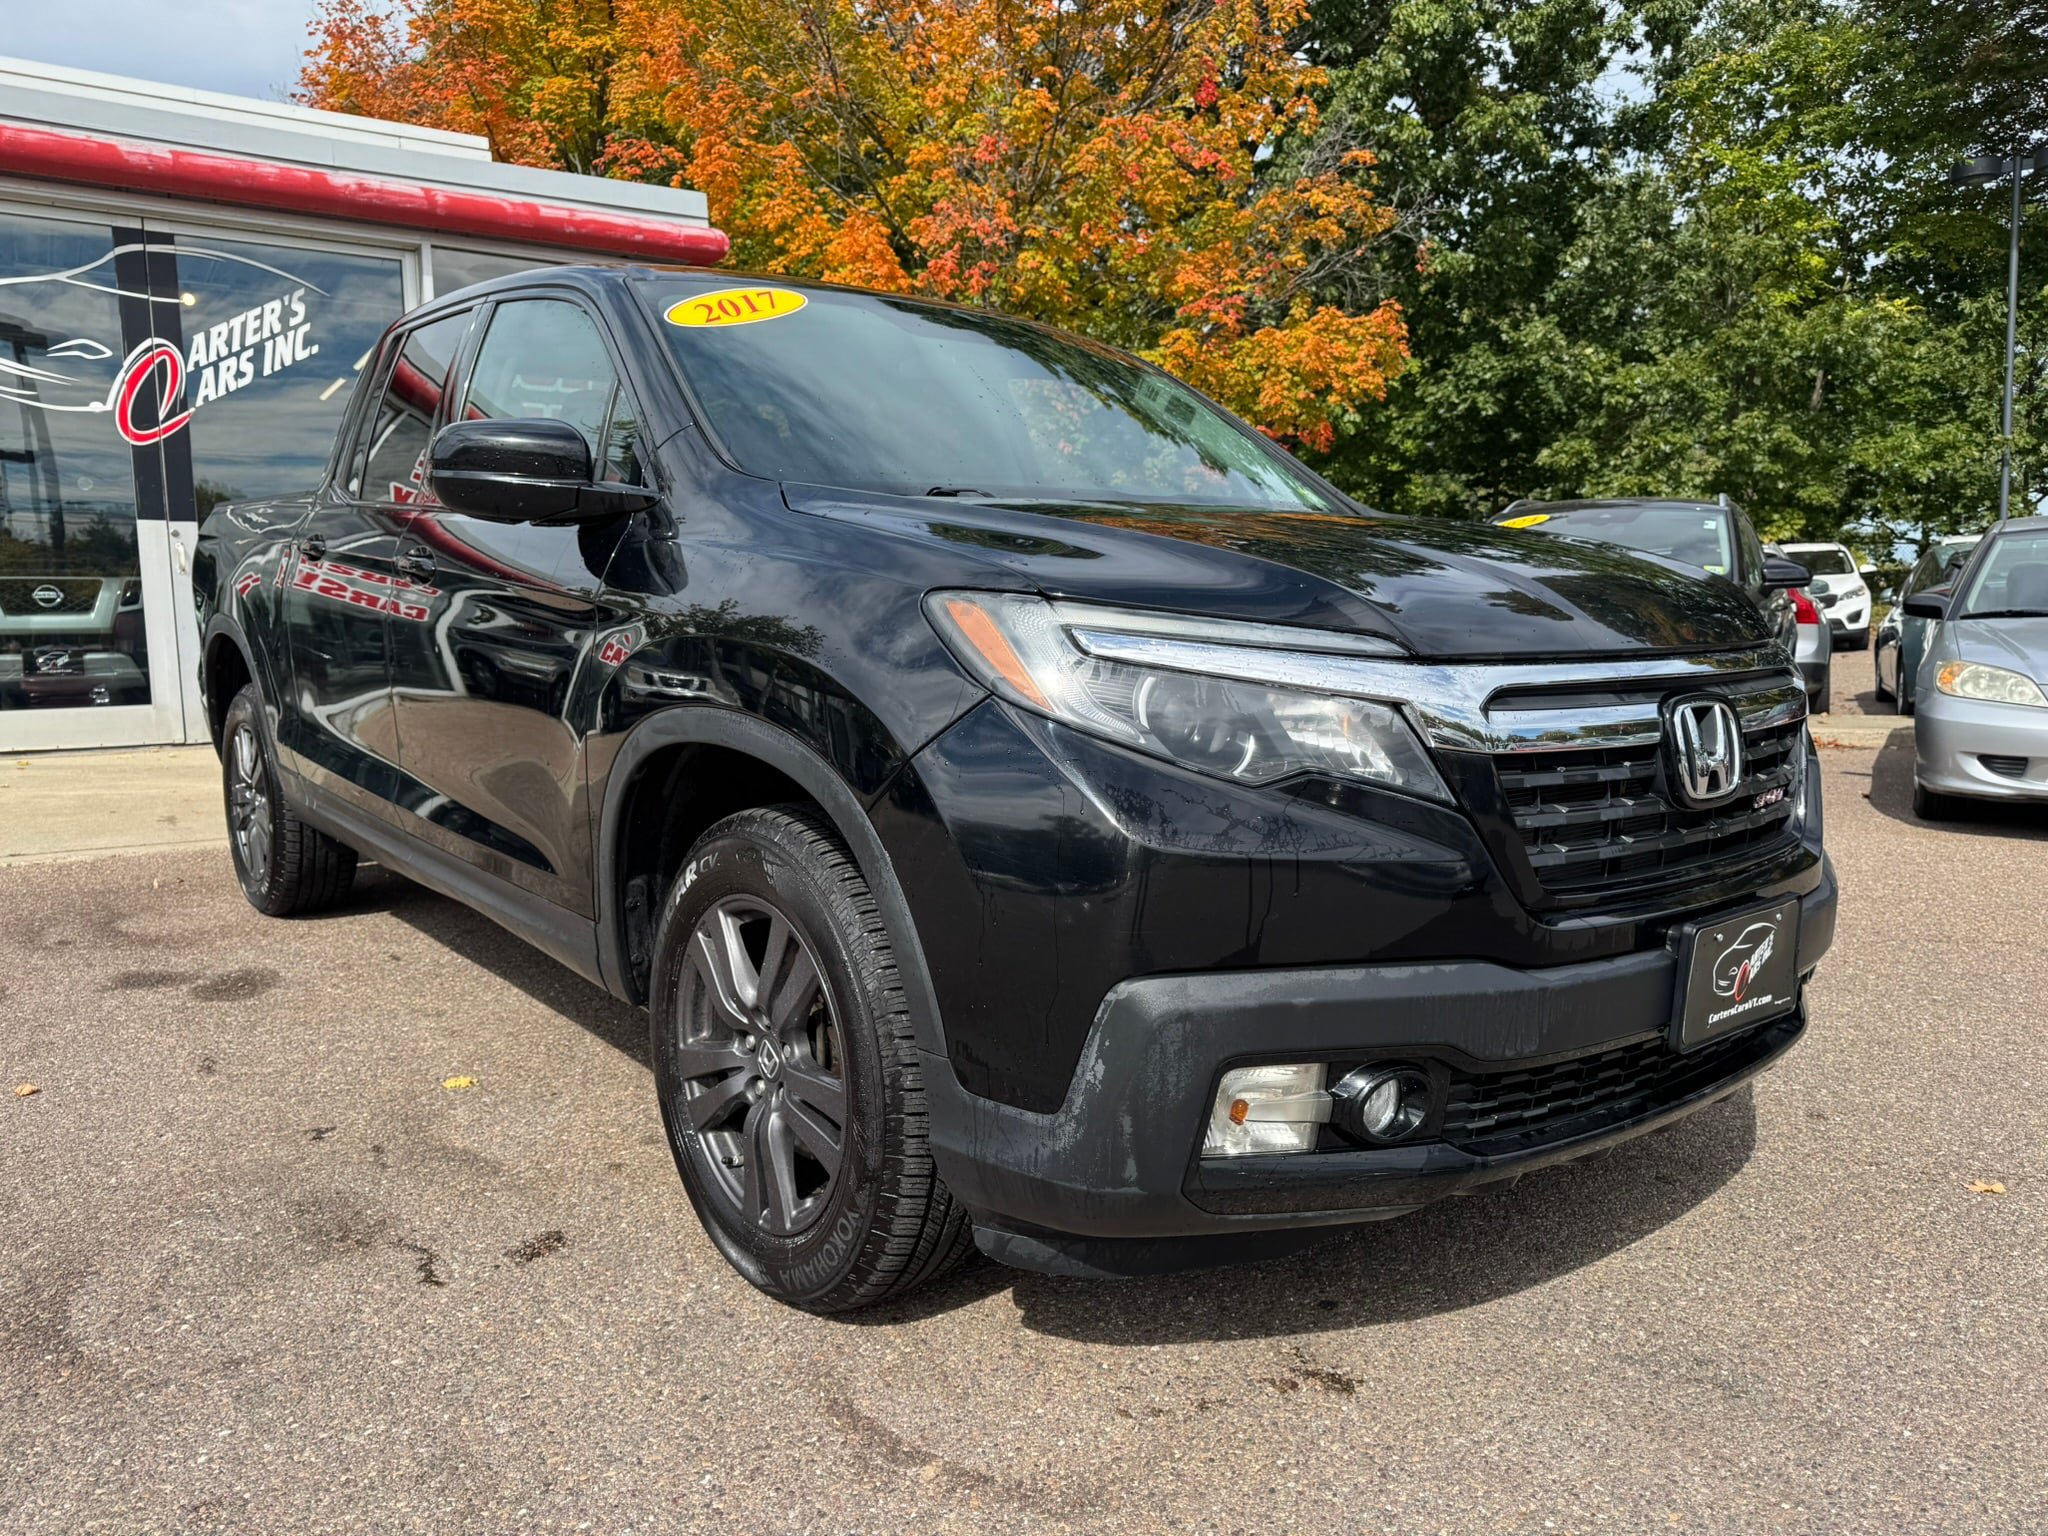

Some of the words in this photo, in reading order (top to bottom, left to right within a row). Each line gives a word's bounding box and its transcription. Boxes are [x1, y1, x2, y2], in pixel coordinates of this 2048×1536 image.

[694, 291, 777, 323] 2017
[263, 323, 320, 377] INC.
[780, 1207, 861, 1290] YOKOHAMA
